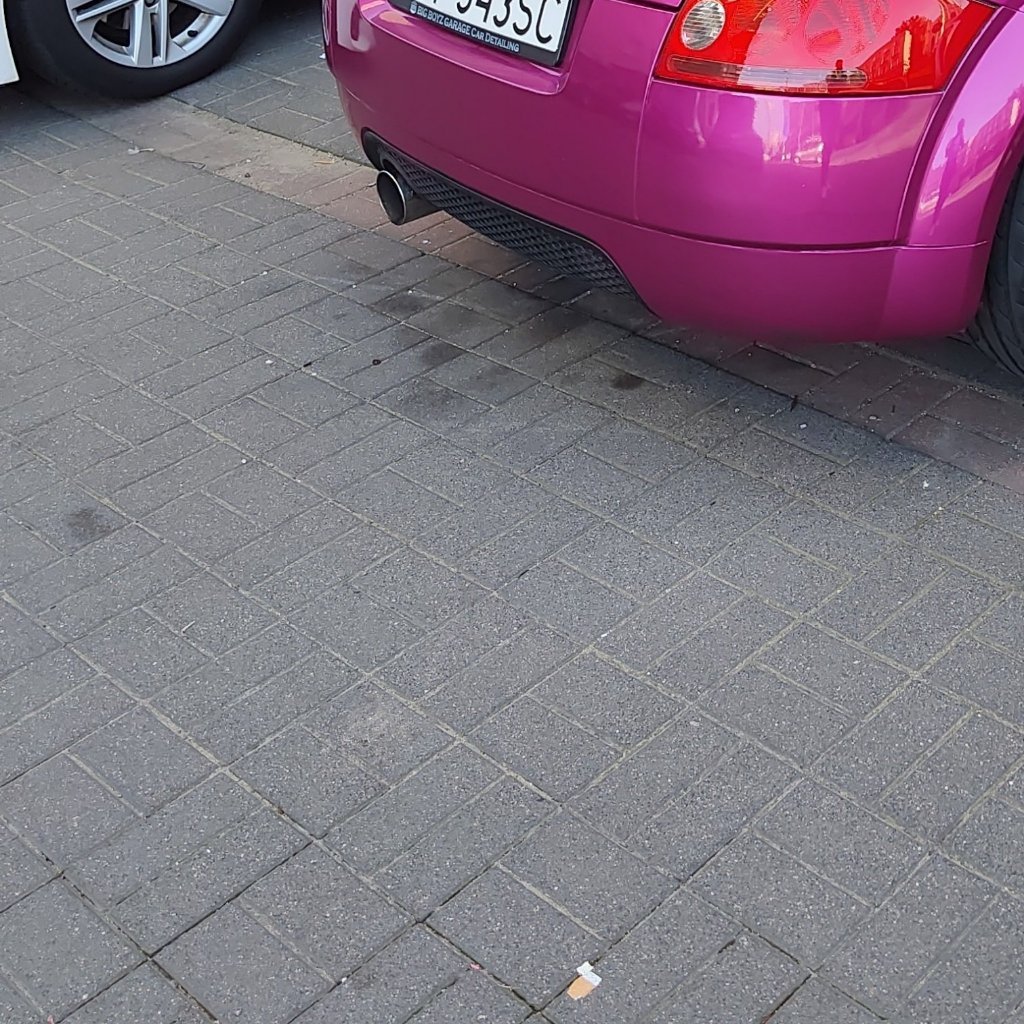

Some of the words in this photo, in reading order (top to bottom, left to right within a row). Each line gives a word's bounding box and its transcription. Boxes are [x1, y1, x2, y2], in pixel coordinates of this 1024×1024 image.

[416, 5, 428, 18] BIG
[427, 9, 444, 25] BOYZ
[444, 17, 471, 35] GARAGE
[484, 33, 520, 53] DETAILING
